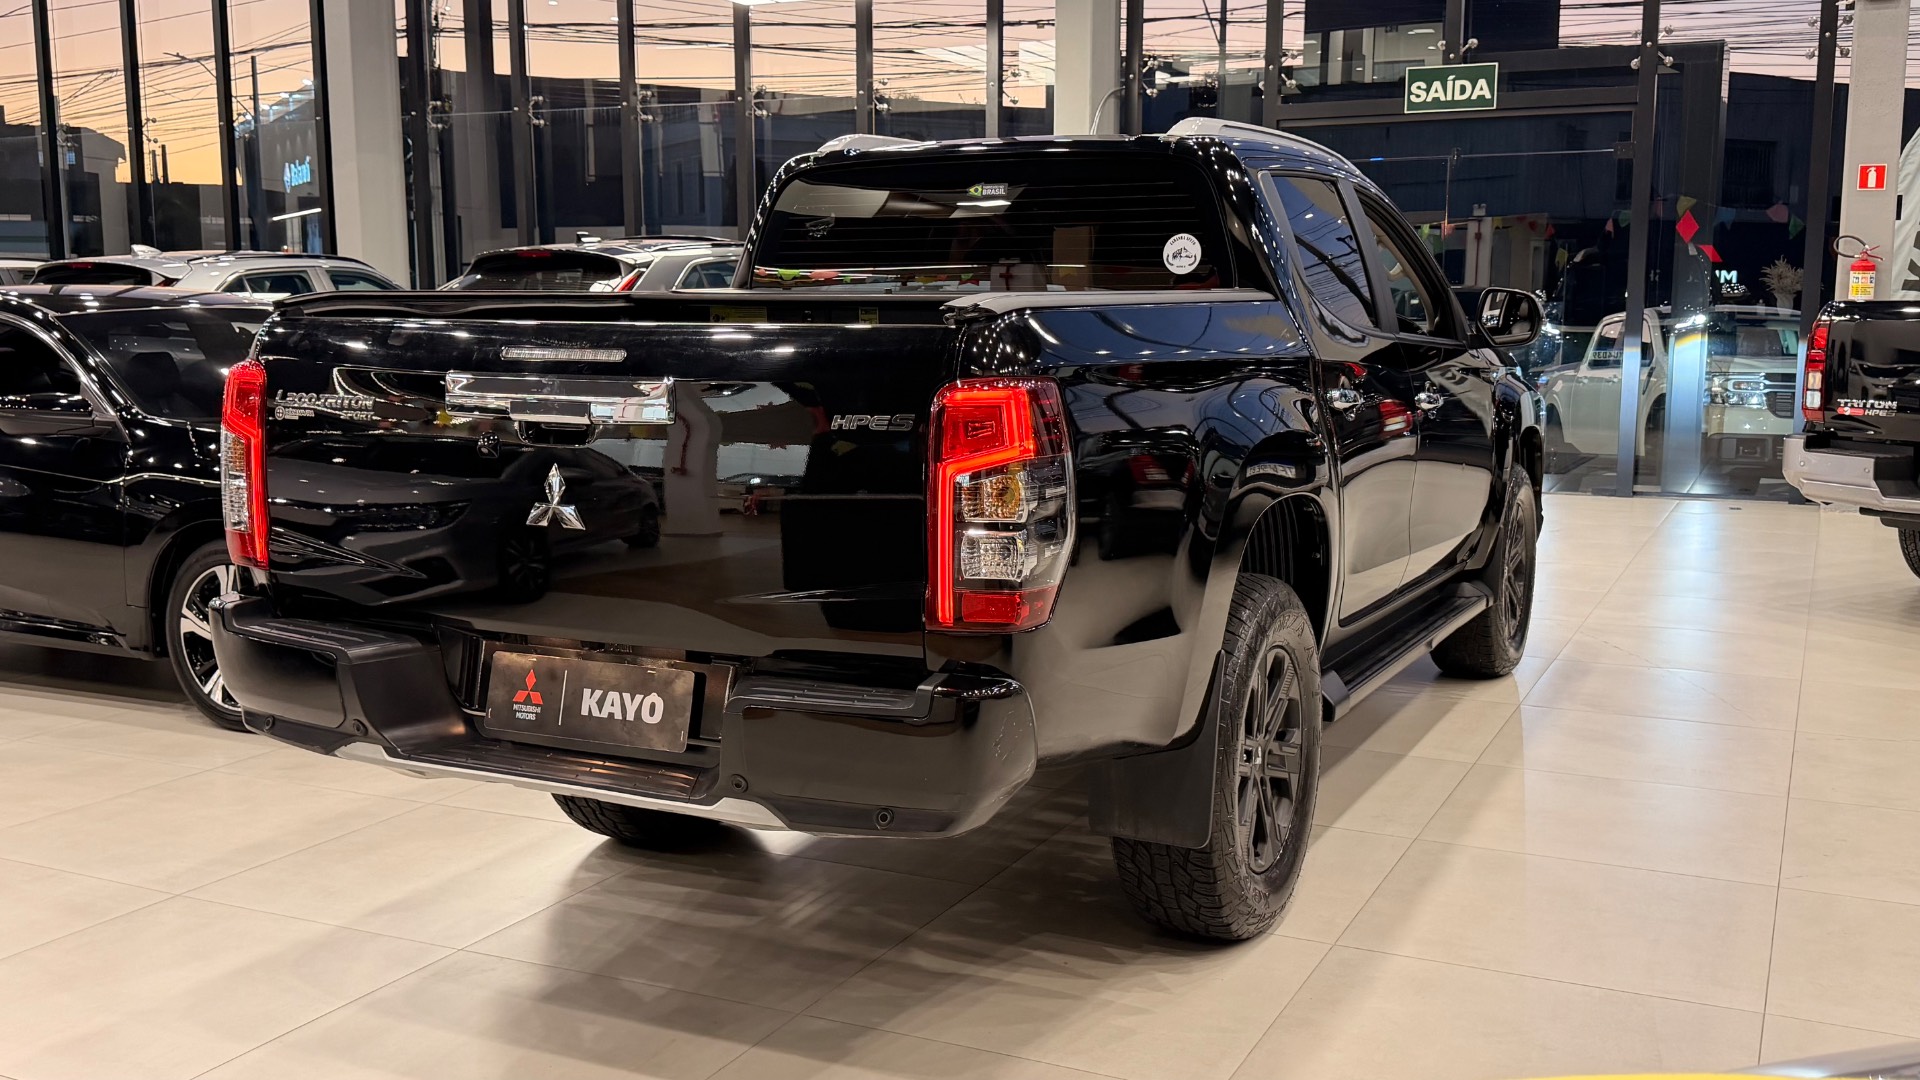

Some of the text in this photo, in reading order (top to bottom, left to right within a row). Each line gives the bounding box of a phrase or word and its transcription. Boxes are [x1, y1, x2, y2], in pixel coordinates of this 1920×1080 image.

[1409, 74, 1492, 103] SAÍDA
[982, 188, 1006, 196] BRASIL
[318, 393, 376, 409] TRITON
[1836, 398, 1898, 409] TRITON
[340, 410, 375, 421] SPORT
[1864, 409, 1898, 417] HPES
[830, 413, 916, 431] HPES
[512, 703, 542, 713] MITSUBISHI
[580, 687, 665, 724] KAYÔ
[515, 711, 537, 720] MOTORS
